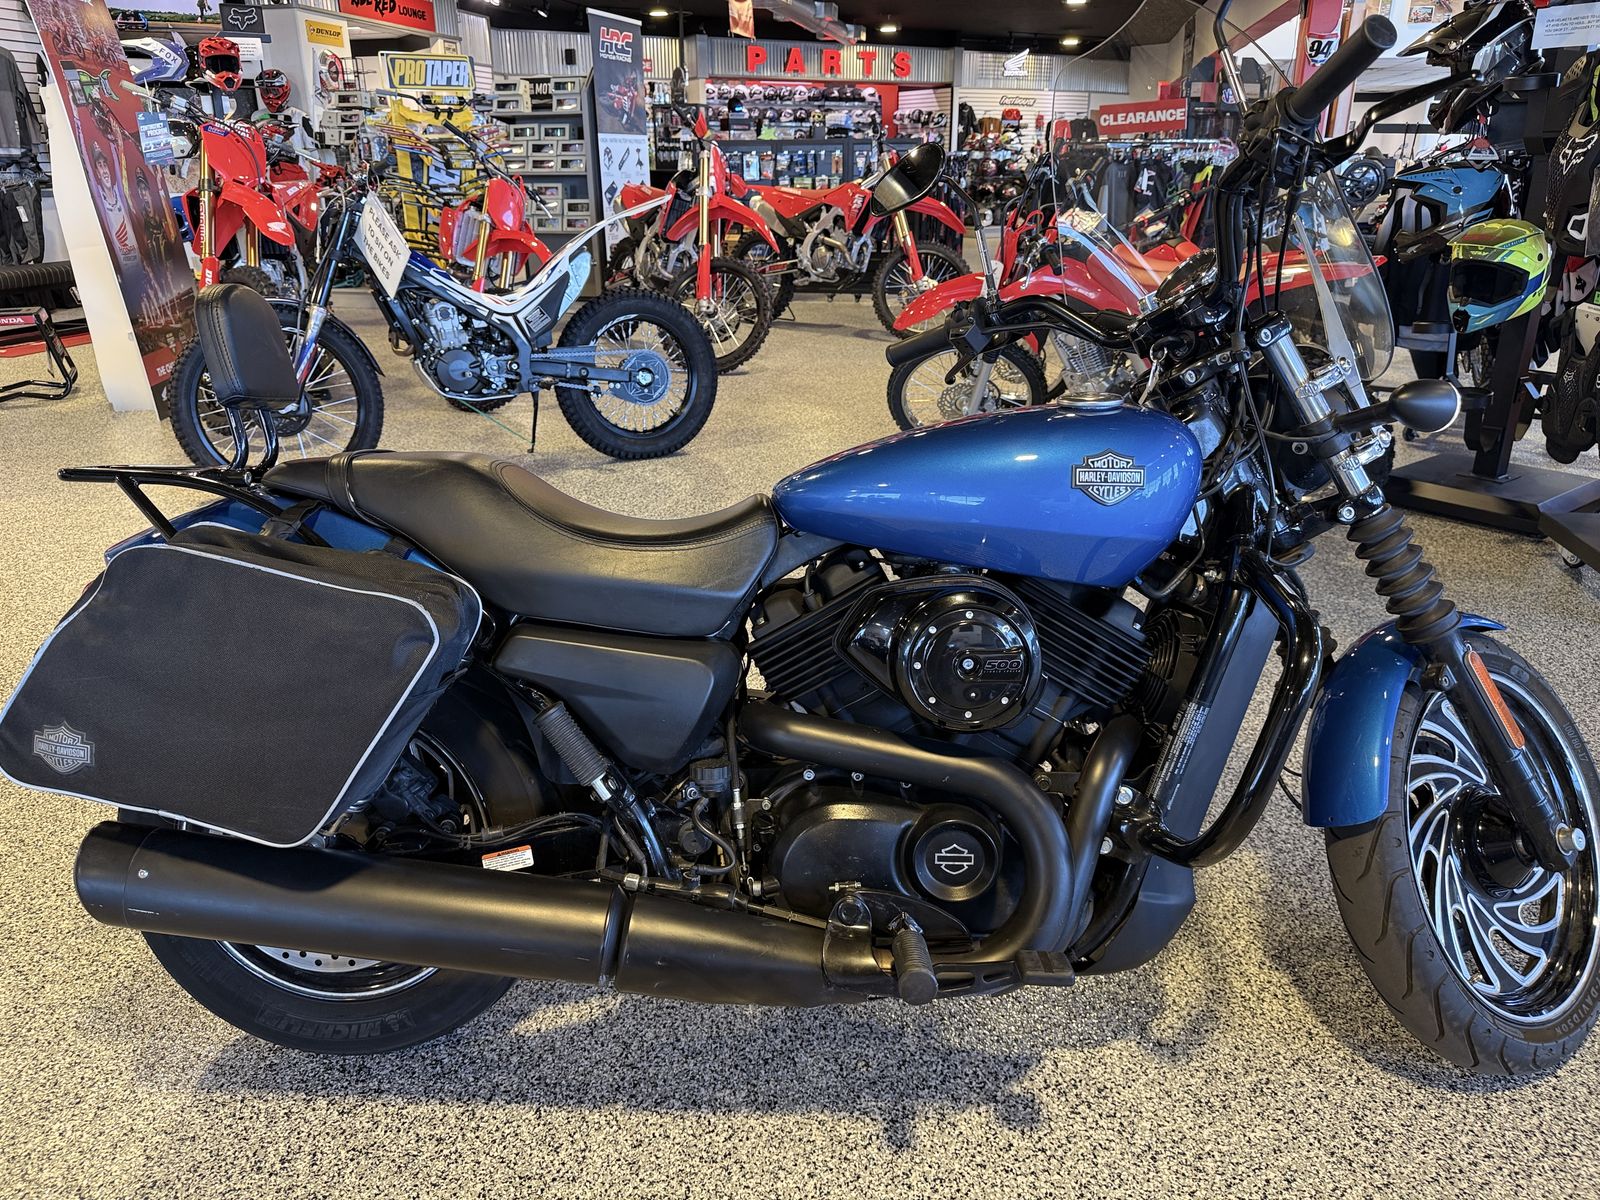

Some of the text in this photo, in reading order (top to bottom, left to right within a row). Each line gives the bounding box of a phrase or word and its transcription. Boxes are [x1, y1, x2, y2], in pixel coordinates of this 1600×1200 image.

[398, 5, 427, 20] LOUNGE
[315, 27, 342, 38] DUNLOP
[600, 26, 633, 58] HRC
[1308, 40, 1334, 58] 94
[158, 47, 179, 64] FOX
[747, 45, 911, 78] PARTS
[1100, 108, 1186, 127] CLEARANCE
[368, 207, 401, 259] PLEASE ASK
[367, 223, 394, 266] TO SIT ON
[363, 234, 390, 280] THE BIKES
[156, 366, 167, 377] THE
[1094, 456, 1127, 469] MOTOR
[1079, 471, 1141, 483] HARLEY-DAVIDSON
[1093, 486, 1126, 500] CYCLES
[984, 659, 1022, 671] 500
[48, 732, 73, 745] MOTOR
[35, 740, 85, 758] HARLEY-DAVIDSON
[47, 755, 73, 769] CYCLES
[257, 1006, 381, 1040] MICHELIN
